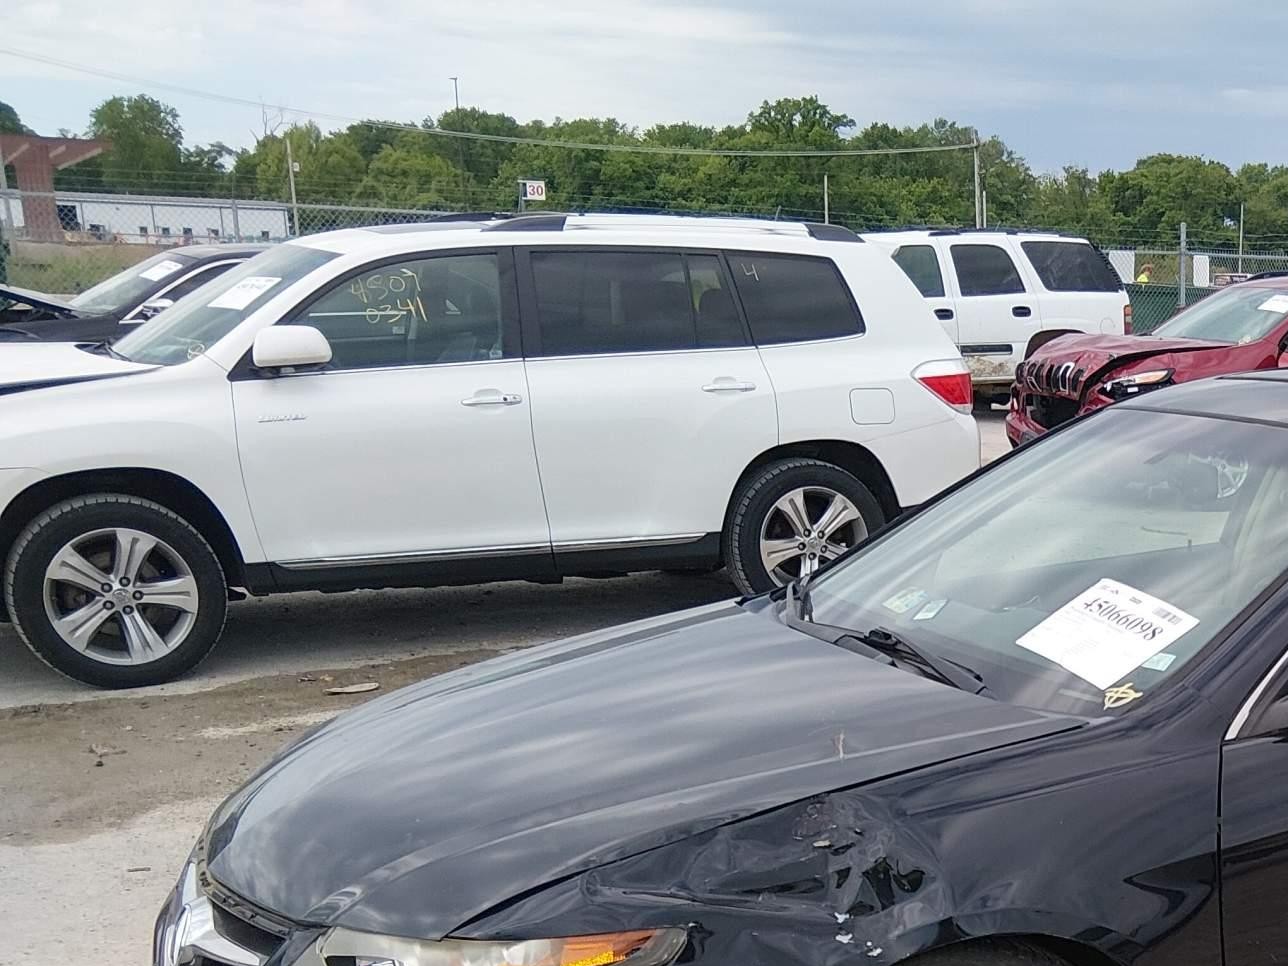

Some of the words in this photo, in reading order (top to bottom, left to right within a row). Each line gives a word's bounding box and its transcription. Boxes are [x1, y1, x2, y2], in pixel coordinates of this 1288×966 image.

[528, 184, 544, 196] 30
[350, 268, 422, 304] 4507
[741, 263, 760, 281] 4
[365, 296, 428, 324] 0341
[1083, 597, 1164, 641] 45066098
